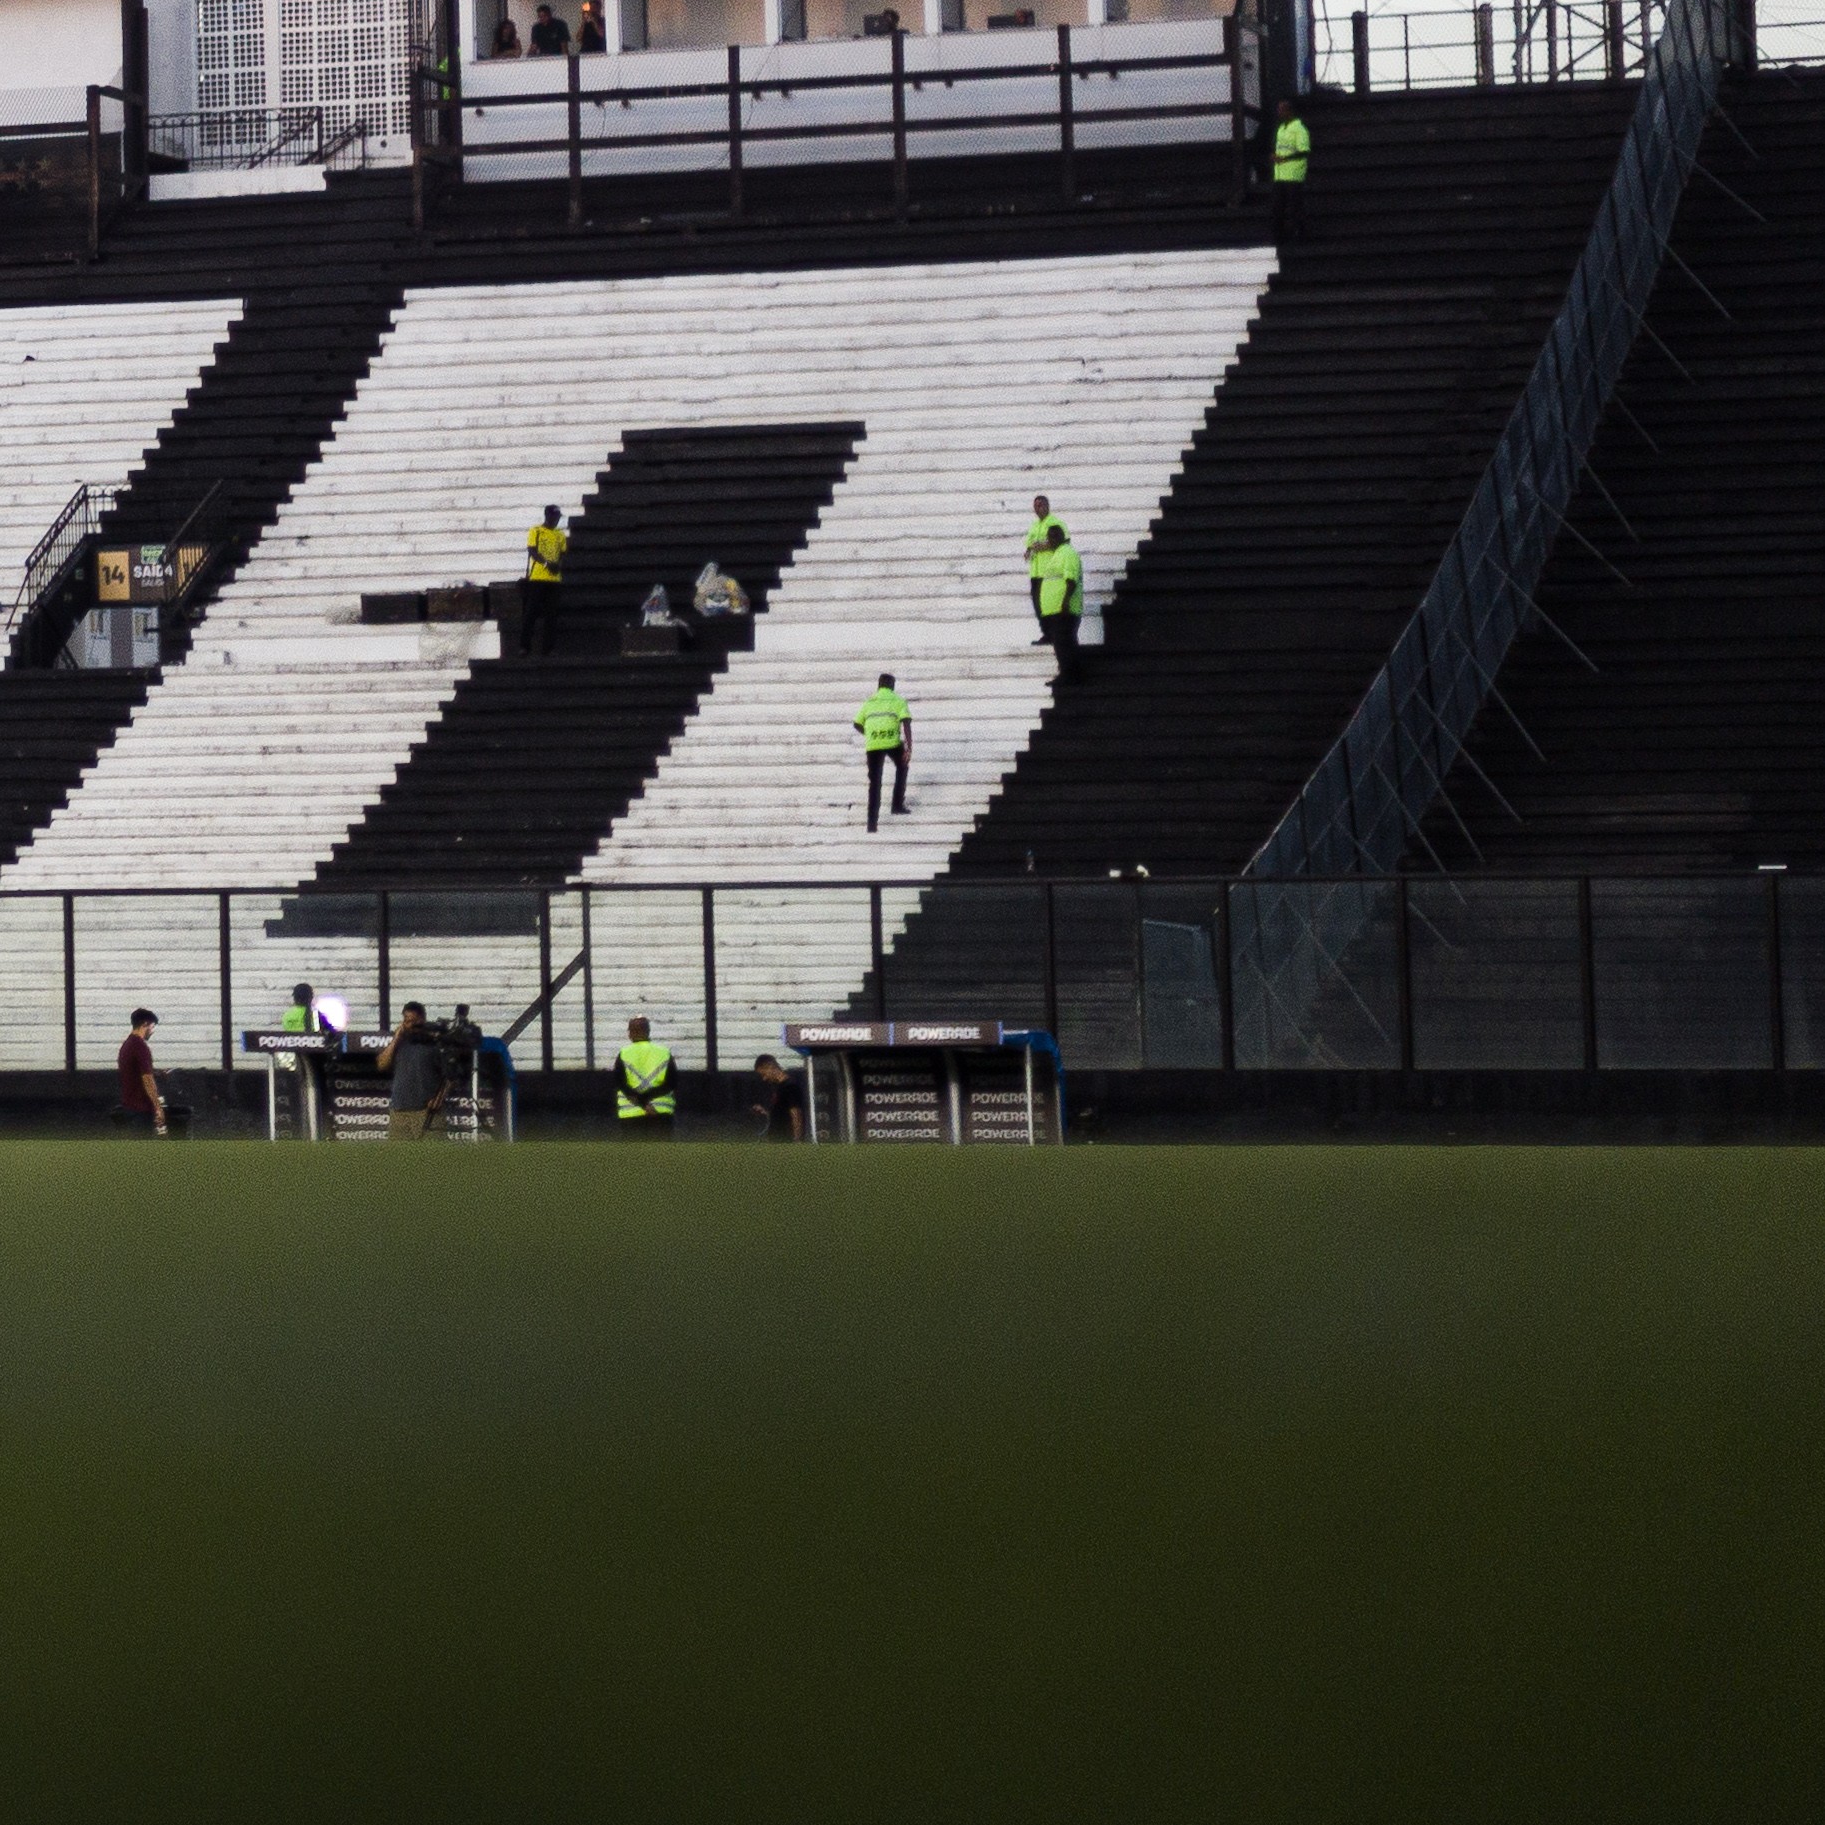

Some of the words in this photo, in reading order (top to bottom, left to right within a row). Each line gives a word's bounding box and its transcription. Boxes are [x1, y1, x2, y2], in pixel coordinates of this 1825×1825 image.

[102, 565, 124, 585] 14
[801, 1028, 872, 1041] POWERADE
[908, 1028, 980, 1040] POWERADE
[259, 1036, 325, 1048] POWERADE
[865, 1093, 938, 1104] POWERADE
[867, 1111, 939, 1122] POWERADE
[868, 1128, 940, 1139] POWERADE
